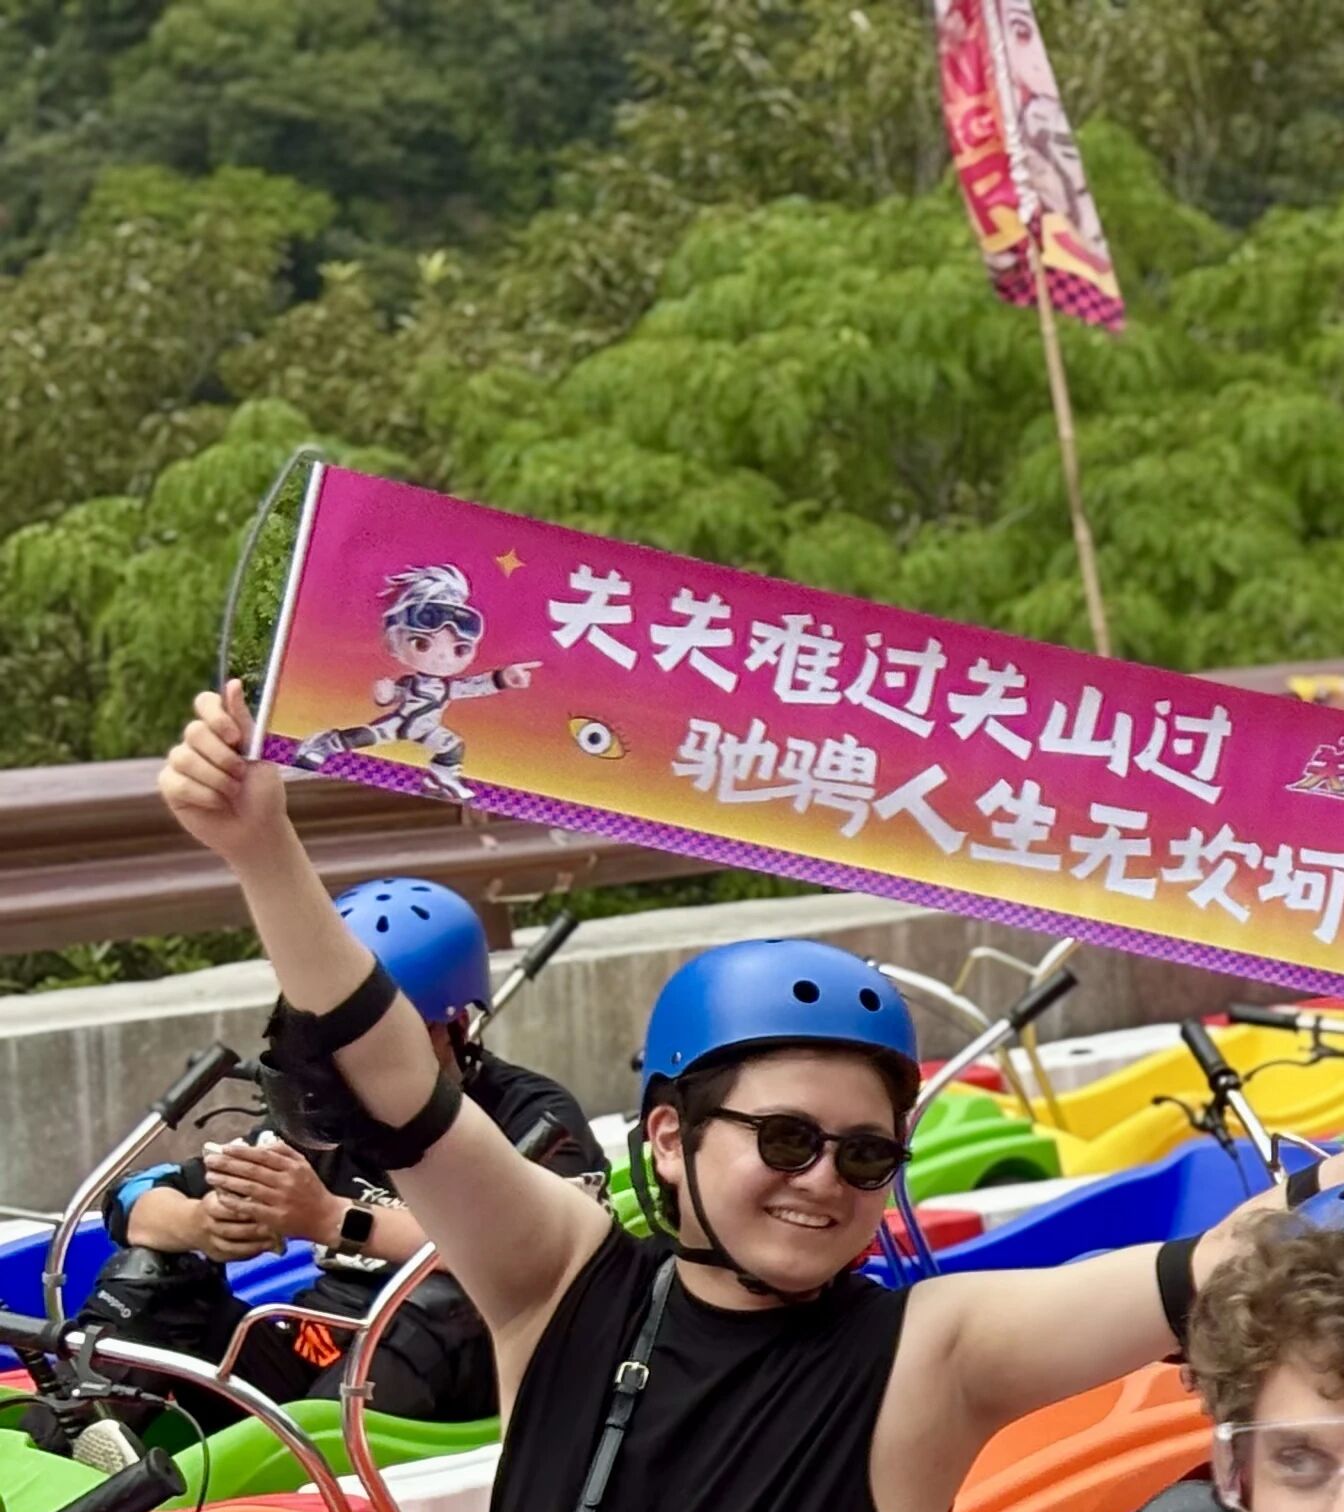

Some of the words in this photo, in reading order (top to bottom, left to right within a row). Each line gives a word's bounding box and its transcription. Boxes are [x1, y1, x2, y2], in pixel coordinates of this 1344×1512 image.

[548, 564, 1233, 805] 关关难过关山过
